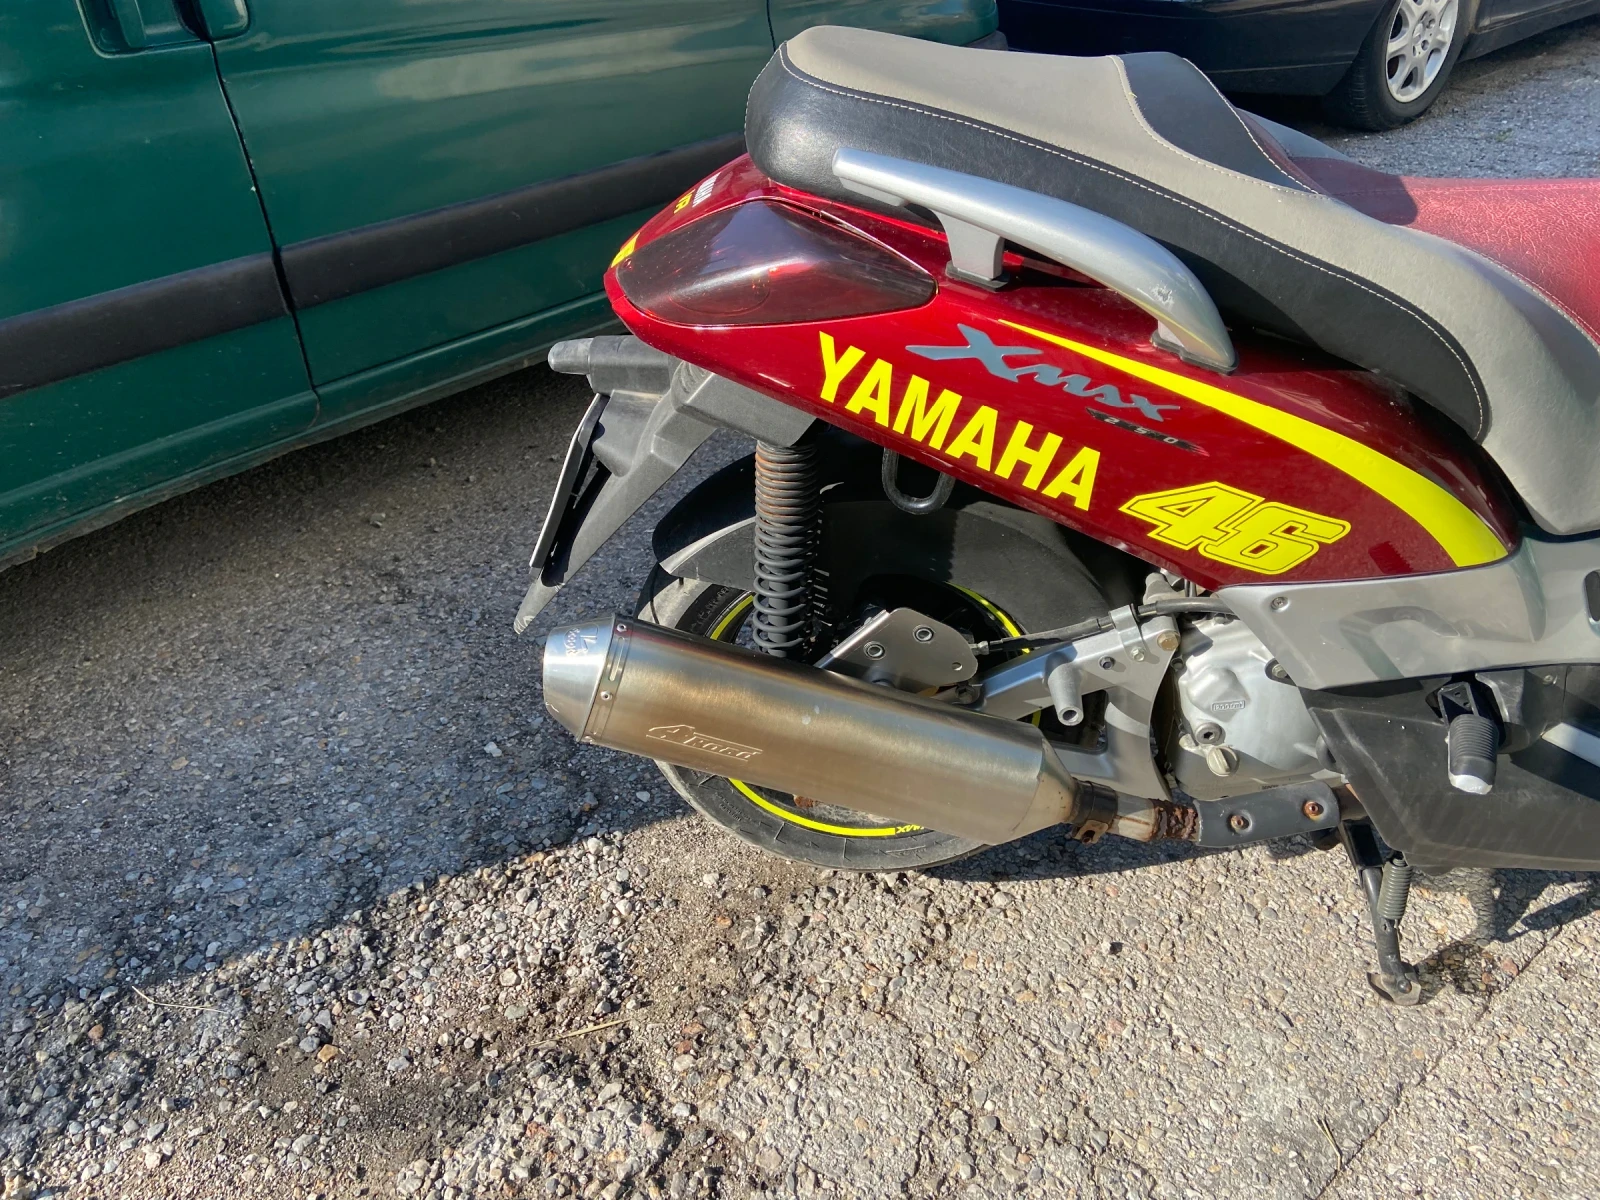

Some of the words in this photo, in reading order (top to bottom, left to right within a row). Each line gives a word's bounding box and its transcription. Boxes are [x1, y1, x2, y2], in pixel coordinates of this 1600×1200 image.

[818, 331, 1101, 512] YAMAHA
[1103, 416, 1179, 444] 250
[1119, 481, 1351, 574] 46
